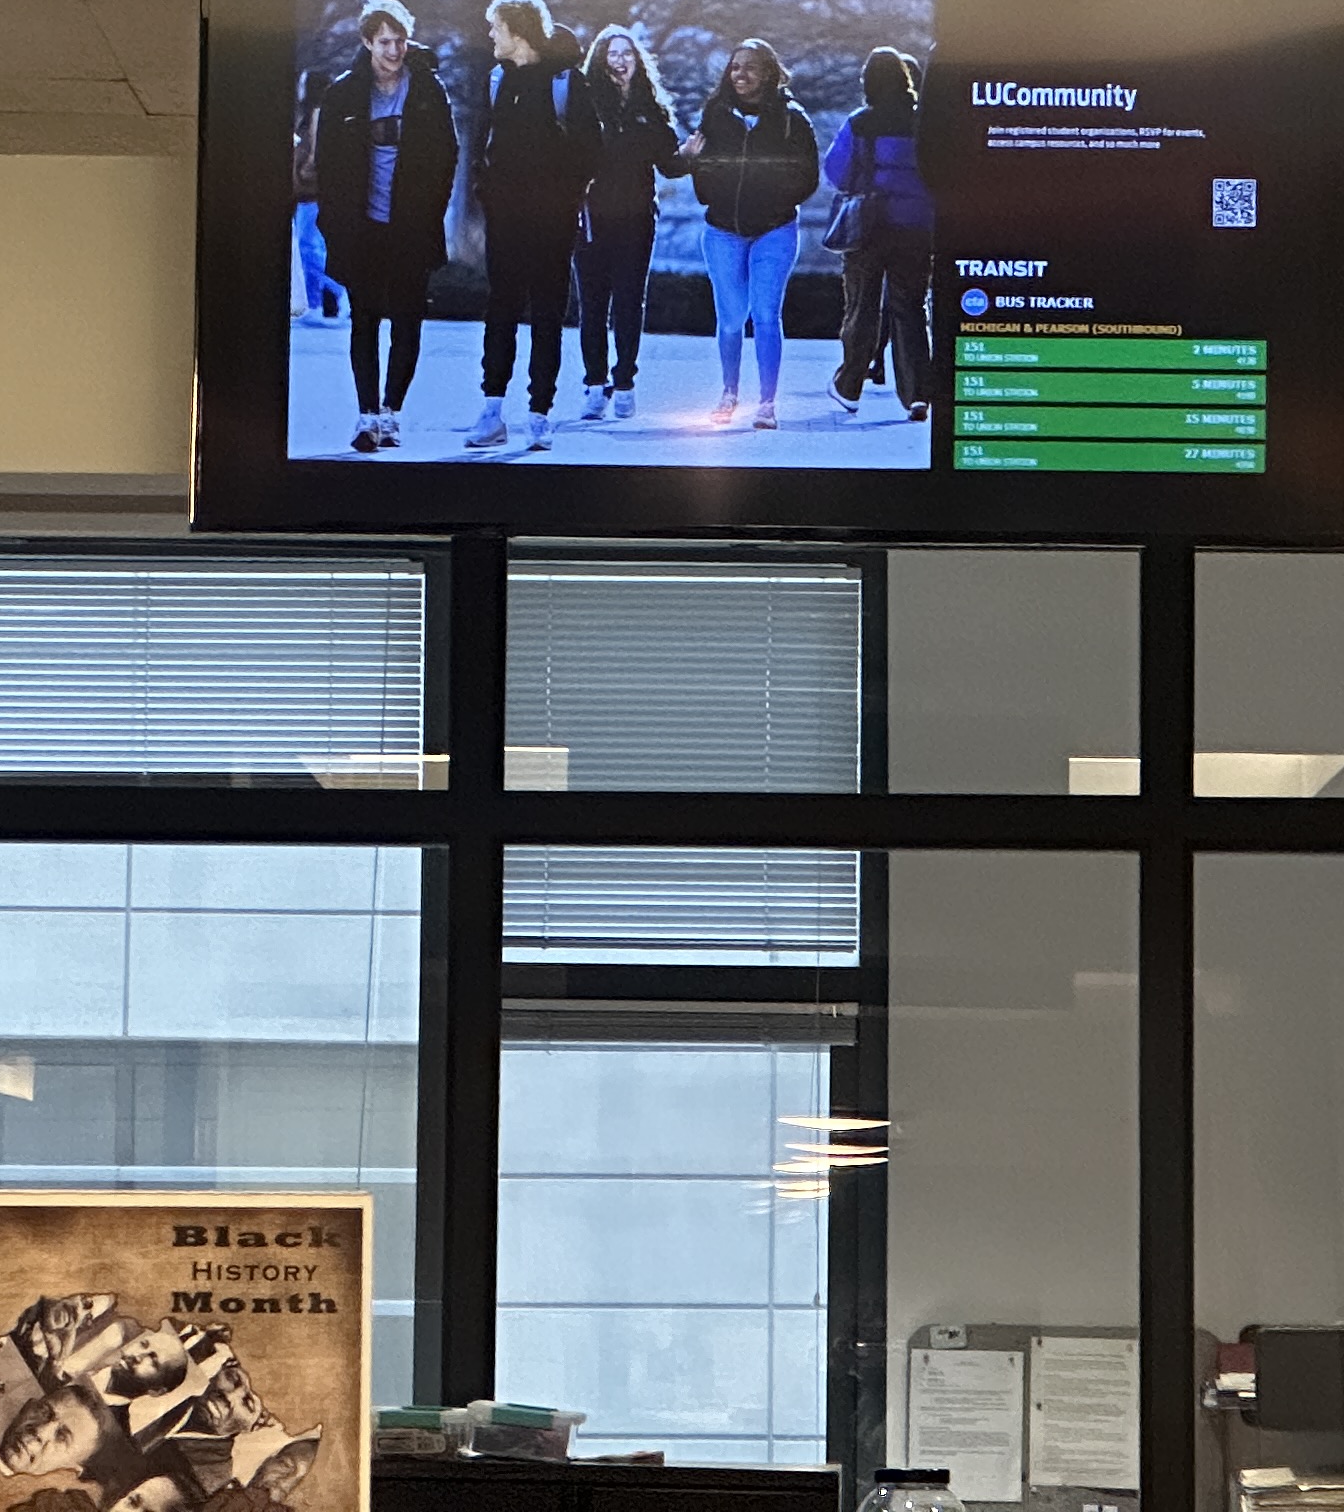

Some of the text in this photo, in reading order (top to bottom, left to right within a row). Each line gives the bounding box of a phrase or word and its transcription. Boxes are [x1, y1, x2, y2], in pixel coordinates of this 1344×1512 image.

[971, 82, 1138, 111] LUCommunity
[955, 260, 1048, 277] TRANSIT
[995, 296, 1094, 309] BUS TRACKER
[960, 322, 1021, 333] MICHIGAN
[1035, 323, 1089, 334] PEARSON
[1092, 324, 1183, 336] (SOUTHBOUND)
[964, 342, 985, 352] 151
[964, 377, 984, 387] 151
[963, 411, 984, 421] 151
[963, 446, 983, 456] 151
[172, 1225, 341, 1247] Black
[192, 1261, 318, 1281] HISTORY
[171, 1291, 338, 1313] Month
